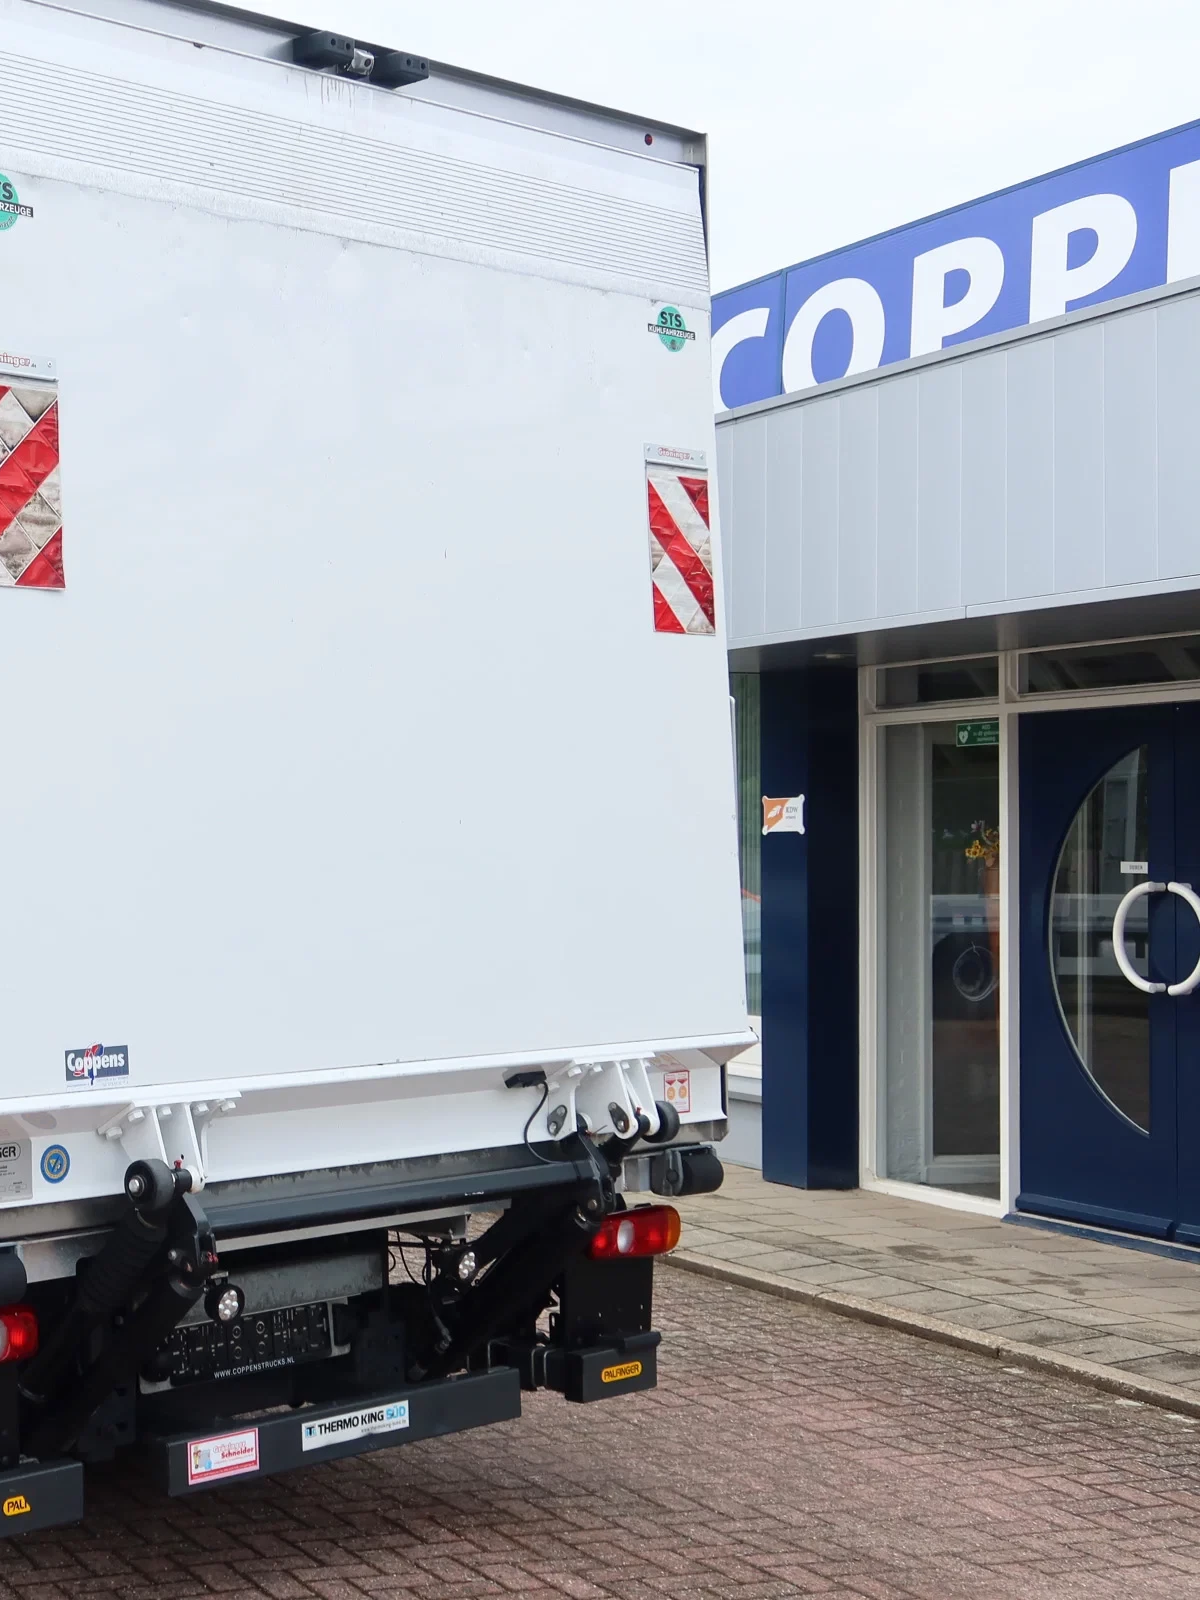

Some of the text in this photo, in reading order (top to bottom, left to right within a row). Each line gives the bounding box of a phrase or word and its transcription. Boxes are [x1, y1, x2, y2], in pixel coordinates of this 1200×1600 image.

[660, 311, 682, 328] STS
[67, 1053, 125, 1077] Coppens
[214, 1356, 295, 1379] WWW.COPPENSTRUCKS.NL
[604, 1363, 640, 1380] PALFINGER
[318, 1404, 406, 1435] THERMO KING SÜD
[221, 1447, 254, 1459] Schneider
